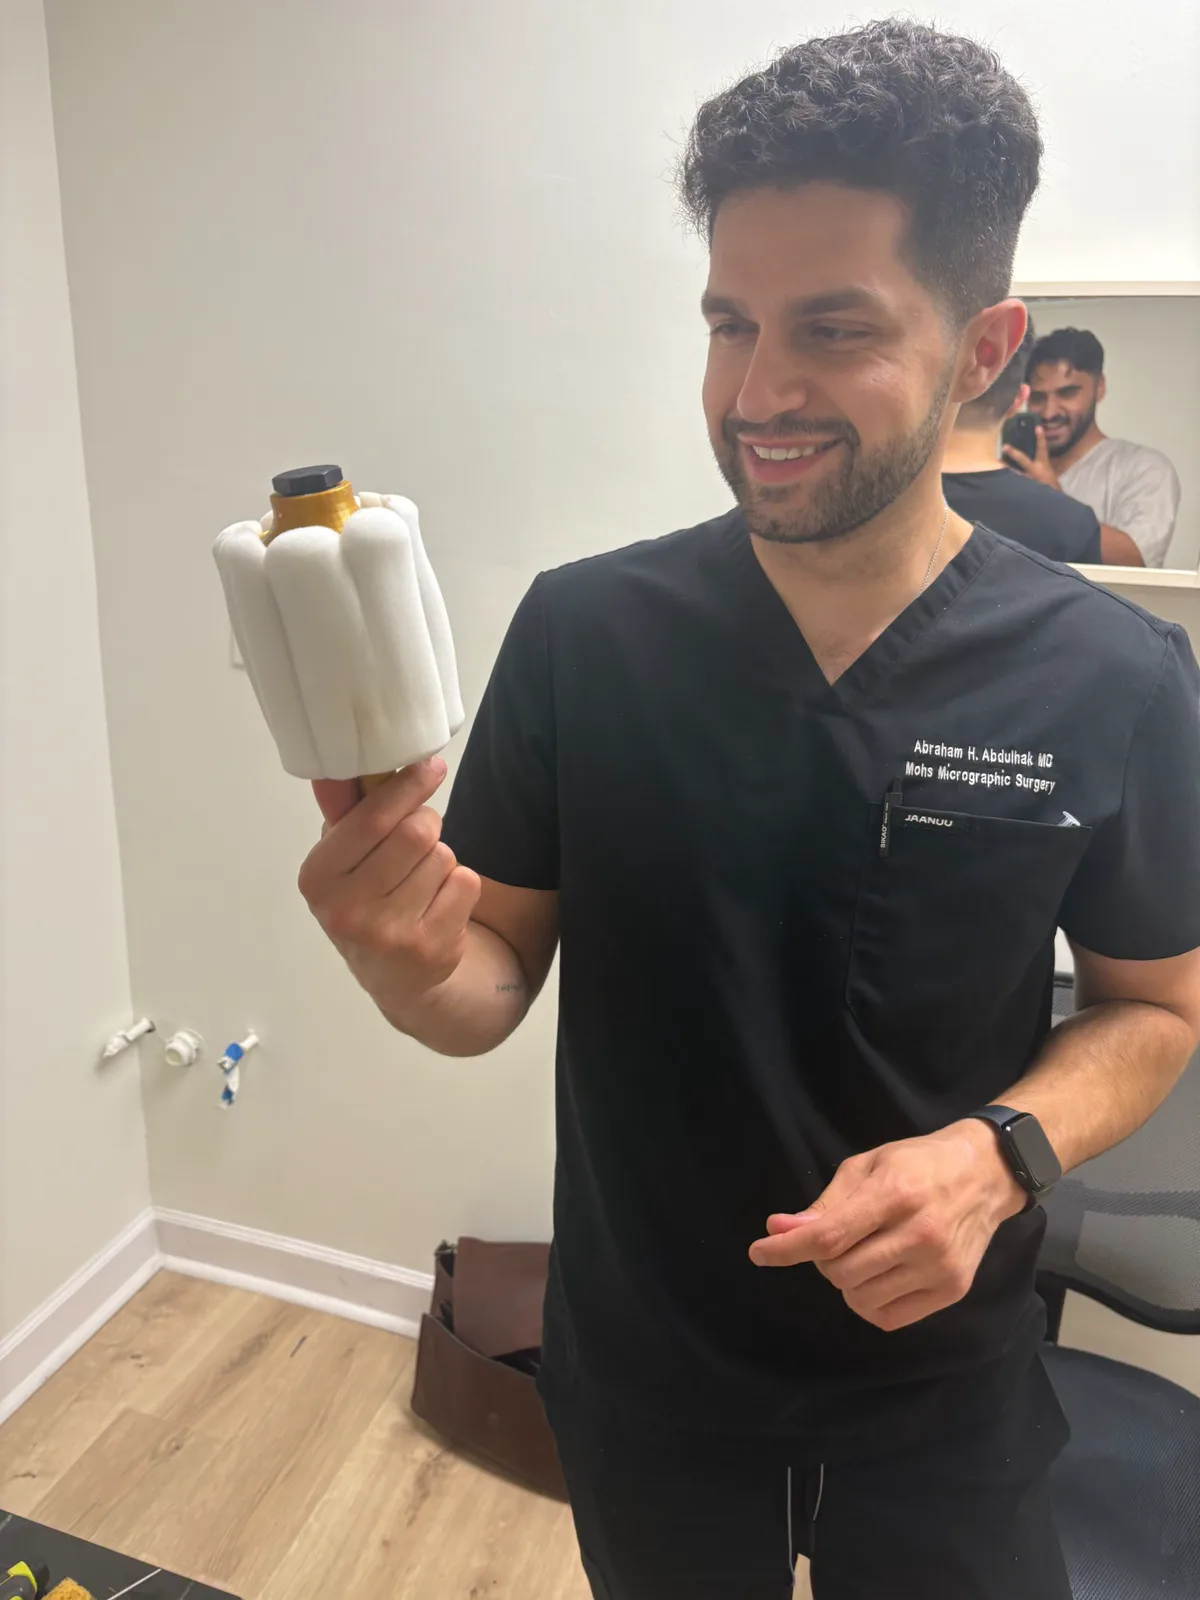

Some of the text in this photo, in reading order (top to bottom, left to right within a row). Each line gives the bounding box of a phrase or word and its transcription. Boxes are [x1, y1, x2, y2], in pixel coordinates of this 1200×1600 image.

[914, 739, 1054, 768] Abraham H. Abdulhak MD
[905, 761, 1056, 795] Mohs Micrographic Surgery
[904, 814, 954, 827] JAANUU
